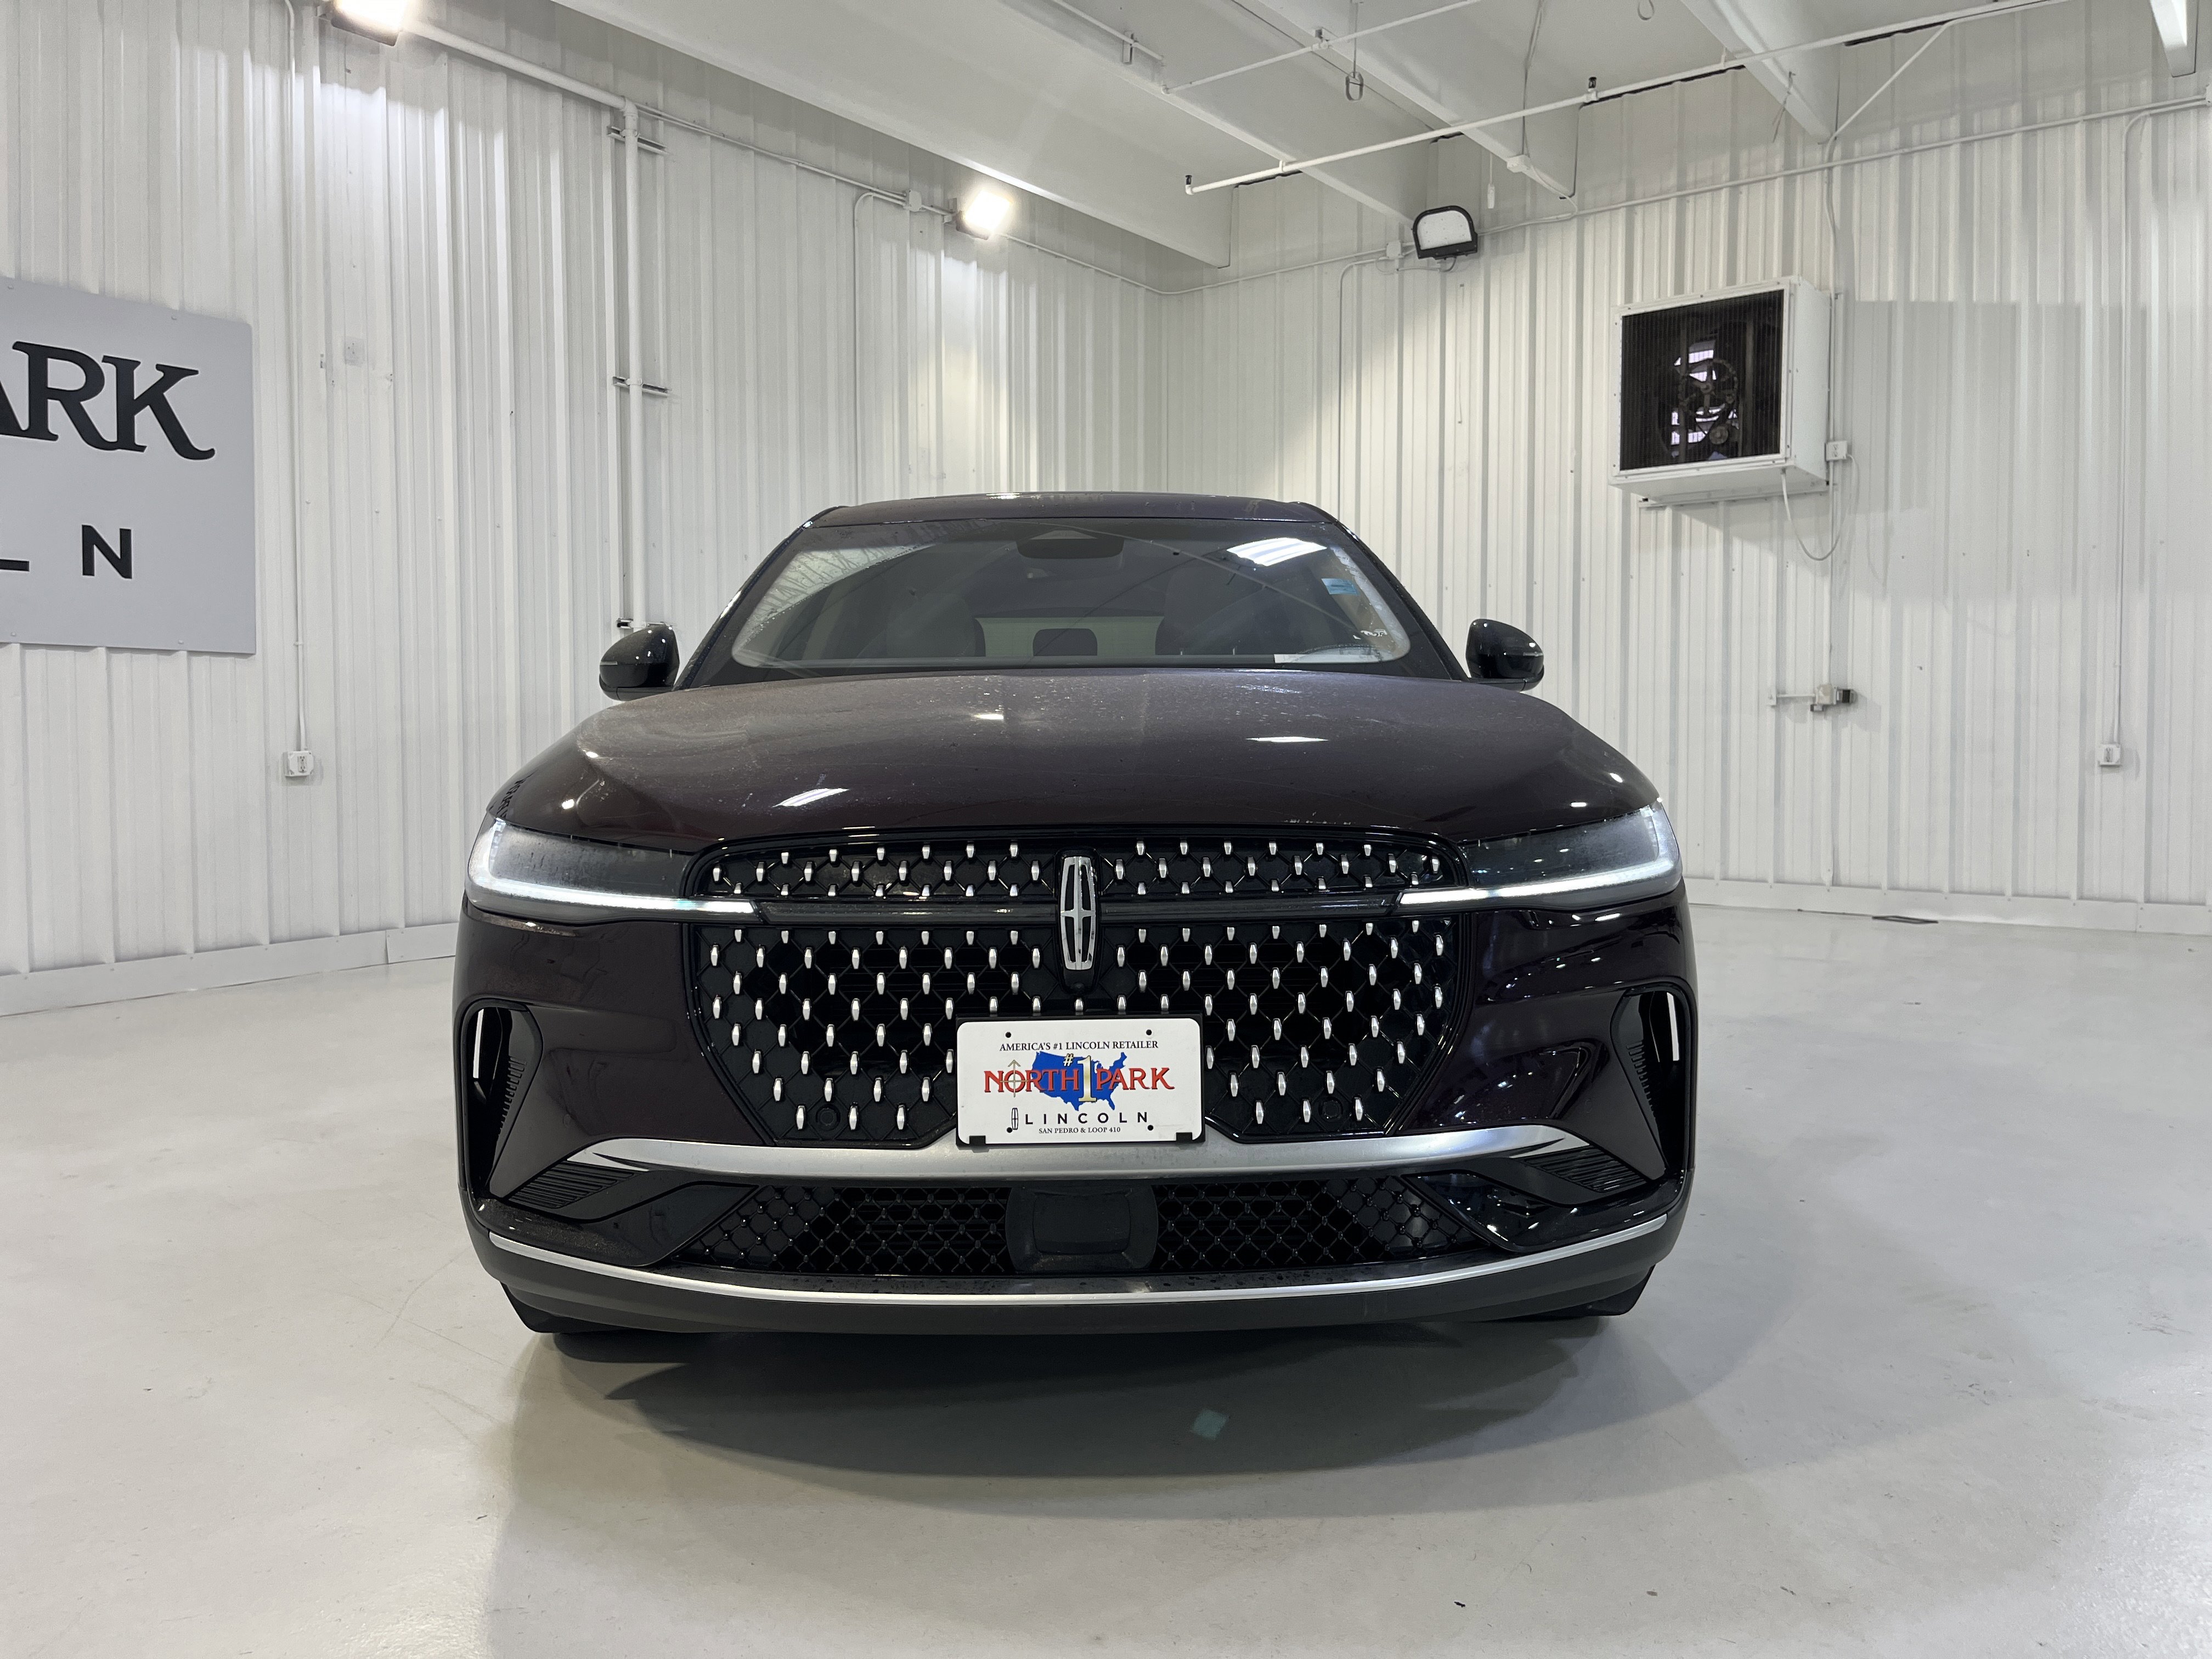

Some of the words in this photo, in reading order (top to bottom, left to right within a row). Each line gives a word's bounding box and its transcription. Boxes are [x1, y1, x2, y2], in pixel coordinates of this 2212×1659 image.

[1000, 1043, 1051, 1051] AMERICA'S
[1065, 1041, 1110, 1050] LINCOLN
[1112, 1040, 1159, 1049] RETAILER
[984, 1069, 1080, 1092] NORTH
[1096, 1067, 1175, 1091] PARK
[1025, 1112, 1148, 1125] LINCOLN
